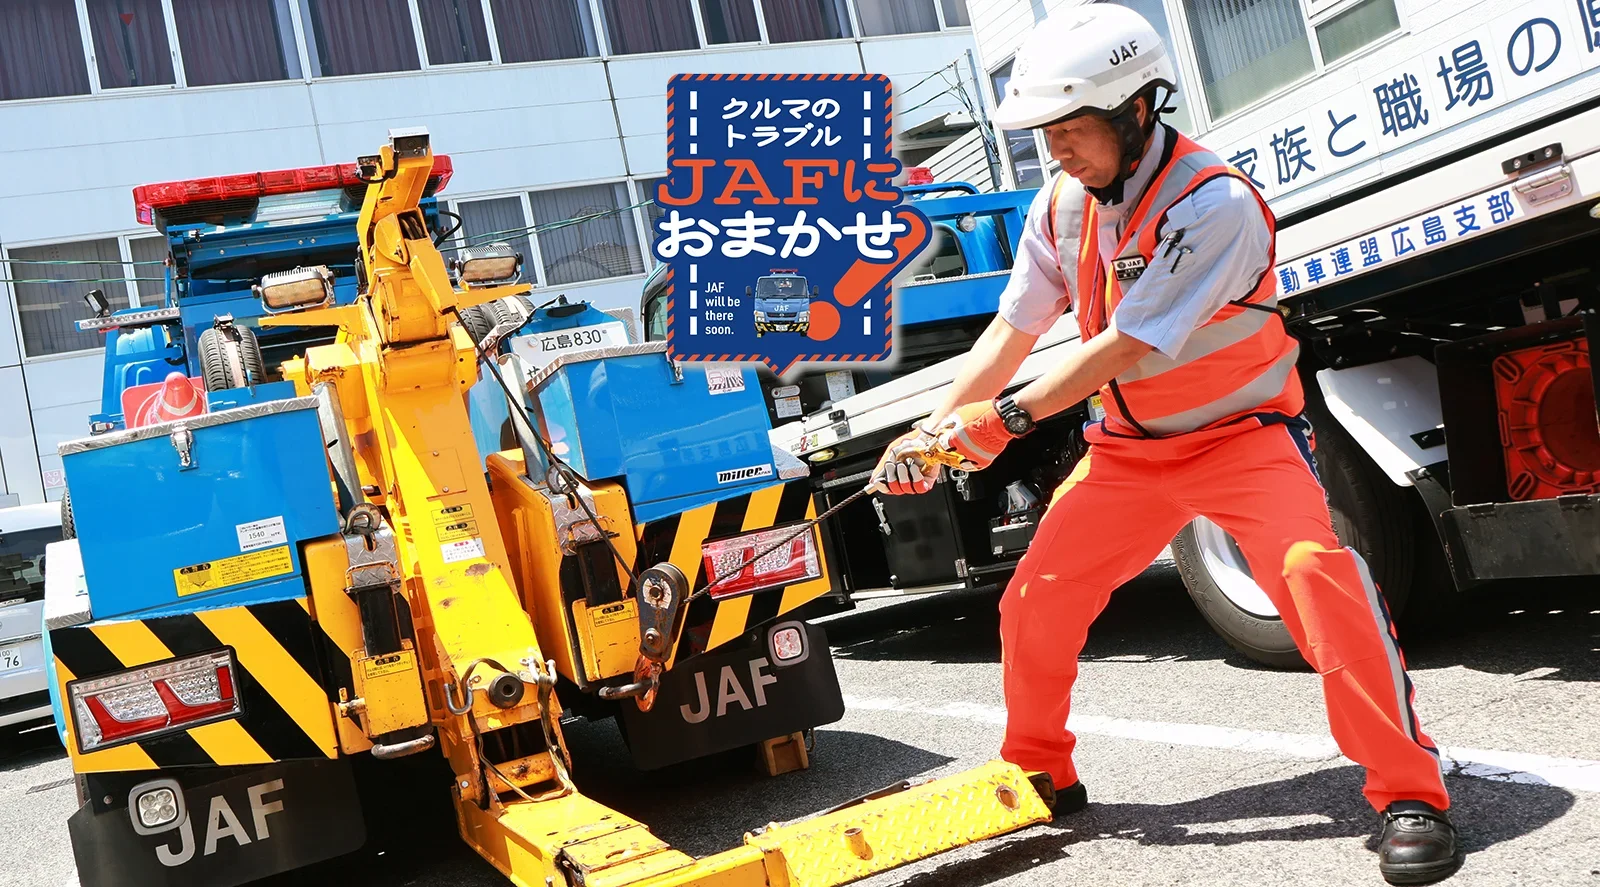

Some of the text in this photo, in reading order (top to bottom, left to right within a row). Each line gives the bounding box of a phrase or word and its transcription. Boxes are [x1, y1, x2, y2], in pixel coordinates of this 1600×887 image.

[1109, 40, 1139, 66] JAF
[1127, 259, 1142, 267] JAF
[719, 466, 763, 482] miller
[249, 530, 265, 540] 1540
[4, 655, 20, 669] 76
[680, 656, 778, 724] JAF
[155, 778, 285, 867] JAF
